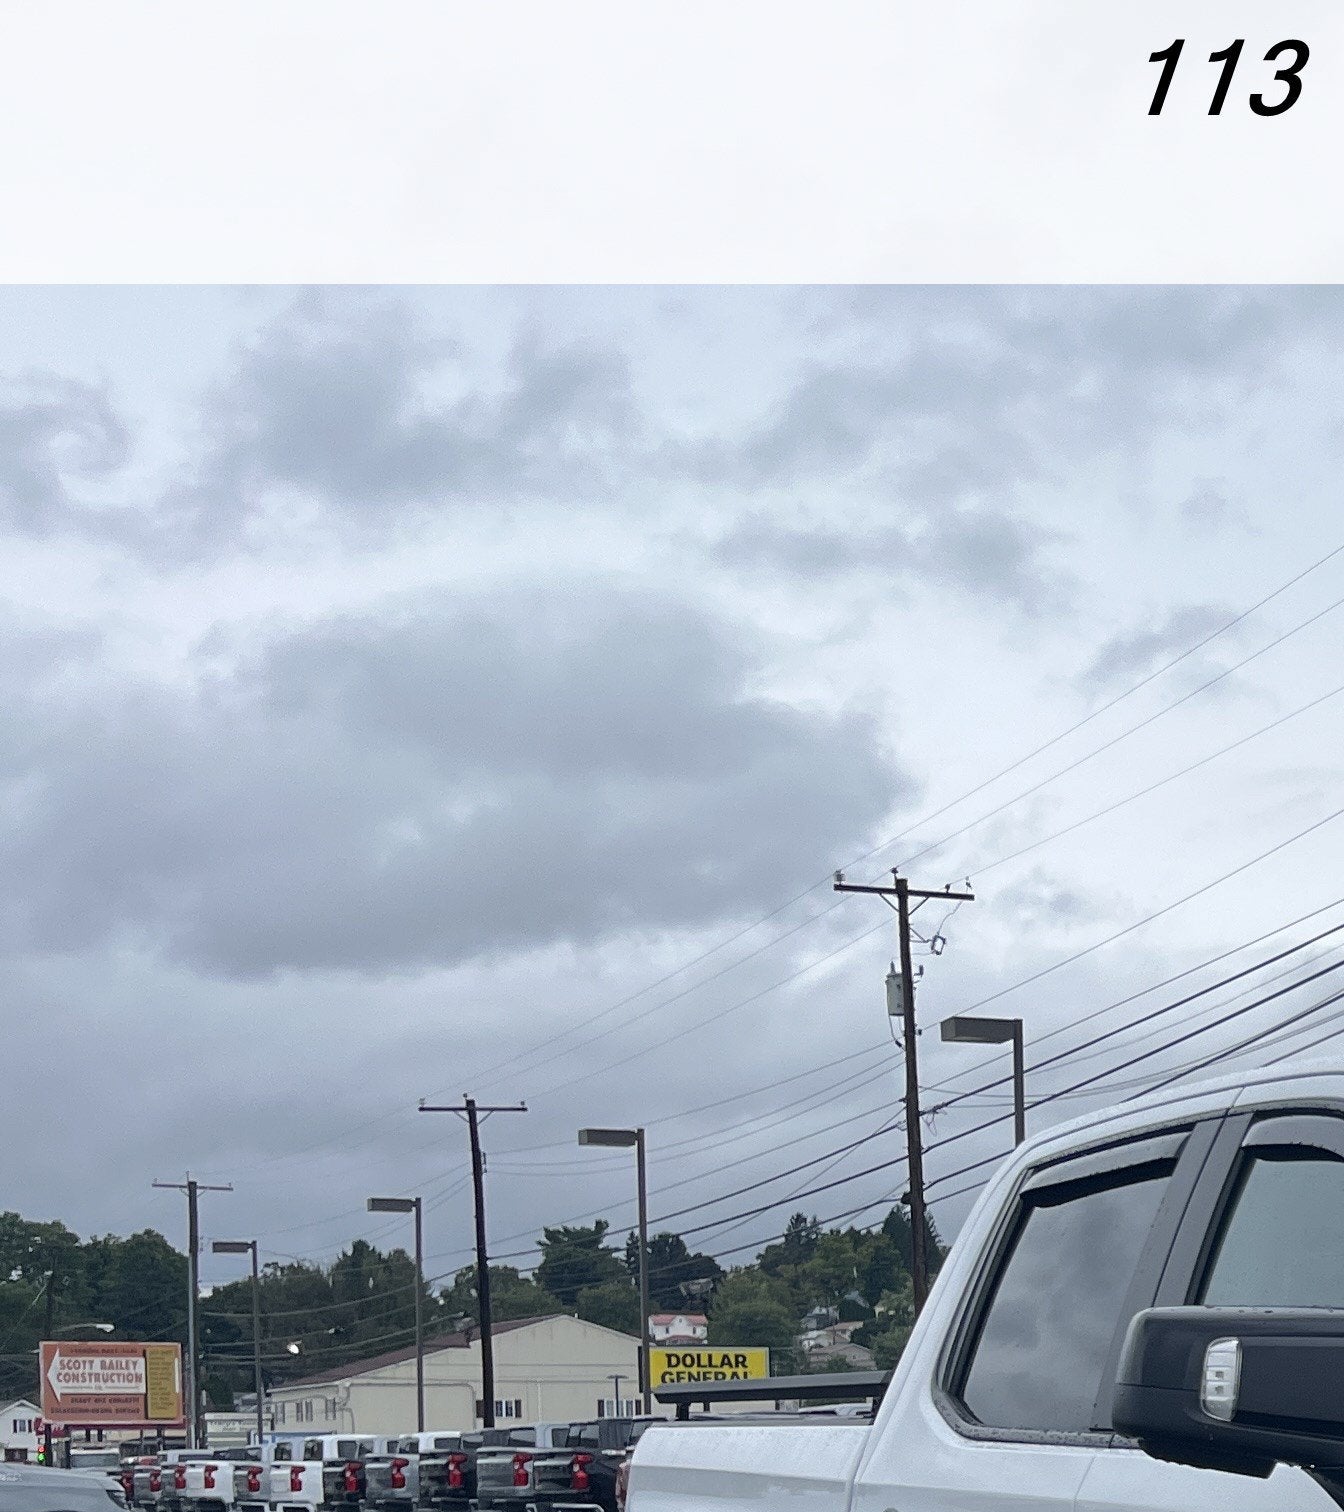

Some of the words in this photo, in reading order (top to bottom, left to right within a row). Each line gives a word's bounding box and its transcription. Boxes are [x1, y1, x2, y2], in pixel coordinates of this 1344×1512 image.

[60, 1359, 94, 1371] SCOTT
[100, 1359, 138, 1371] BAILEY
[665, 1352, 748, 1368] DOLLAR
[57, 1372, 143, 1384] CONSTRUCTION
